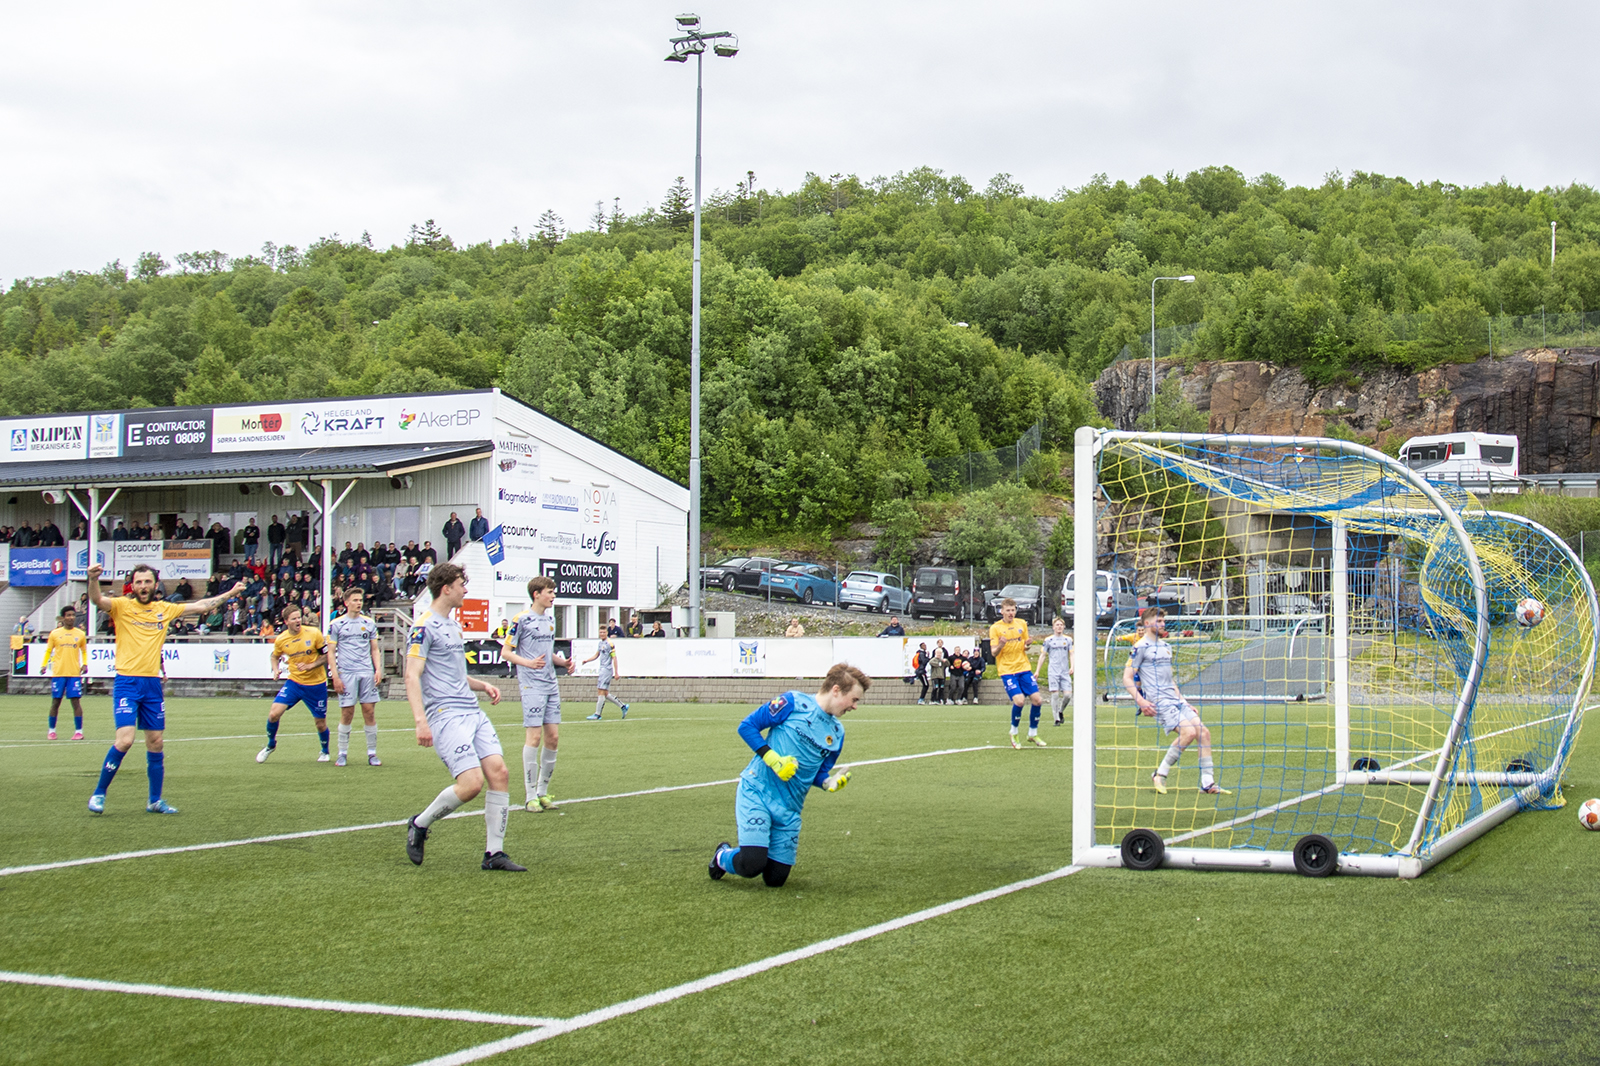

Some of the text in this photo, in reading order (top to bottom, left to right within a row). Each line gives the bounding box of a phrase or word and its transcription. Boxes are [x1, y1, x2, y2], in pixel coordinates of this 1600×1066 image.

[324, 409, 372, 417] HELGELAND
[417, 409, 481, 428] AkerBP
[146, 420, 206, 433] CONTRACTOR
[241, 416, 280, 430] Montér
[324, 416, 385, 432] KRAFT
[31, 426, 82, 442] SLIPEN
[146, 431, 206, 446] BYGG 08089
[31, 441, 82, 451] MEKANISKE AS
[499, 440, 532, 454] MATHISEN
[584, 489, 616, 506] NOVA
[502, 525, 537, 537] ccountor
[117, 542, 160, 553] accountor
[11, 559, 51, 570] SpareBank
[560, 563, 612, 578] CONTRACTOR
[560, 580, 612, 595] BYGG 08089
[500, 807, 508, 833] Scandic
